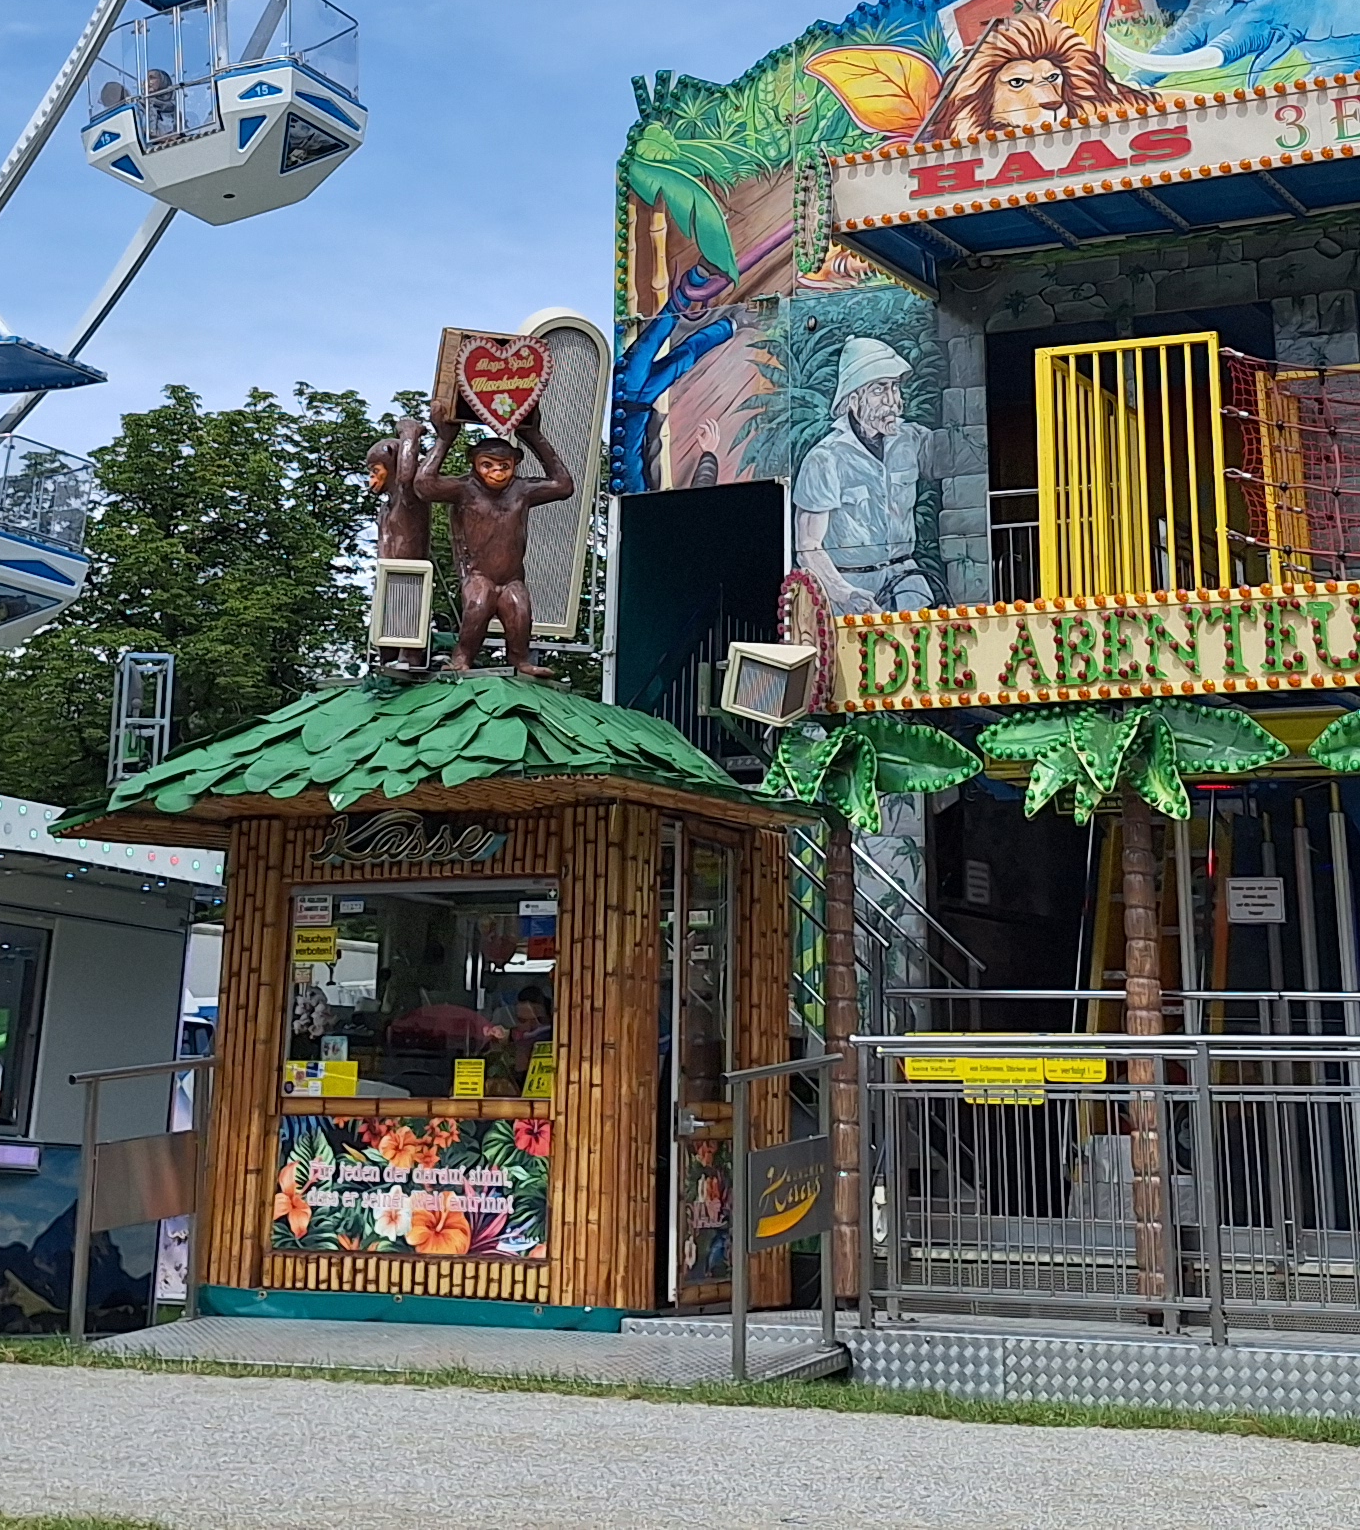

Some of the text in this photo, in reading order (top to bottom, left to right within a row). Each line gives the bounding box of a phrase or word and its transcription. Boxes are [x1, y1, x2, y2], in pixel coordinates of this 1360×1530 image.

[254, 84, 269, 96] 15
[1274, 104, 1311, 152] 3
[908, 125, 1193, 200] HAAS
[857, 620, 978, 696] DIE
[309, 809, 495, 863] Kasse
[297, 934, 332, 943] Rauchen
[383, 1164, 410, 1183] der
